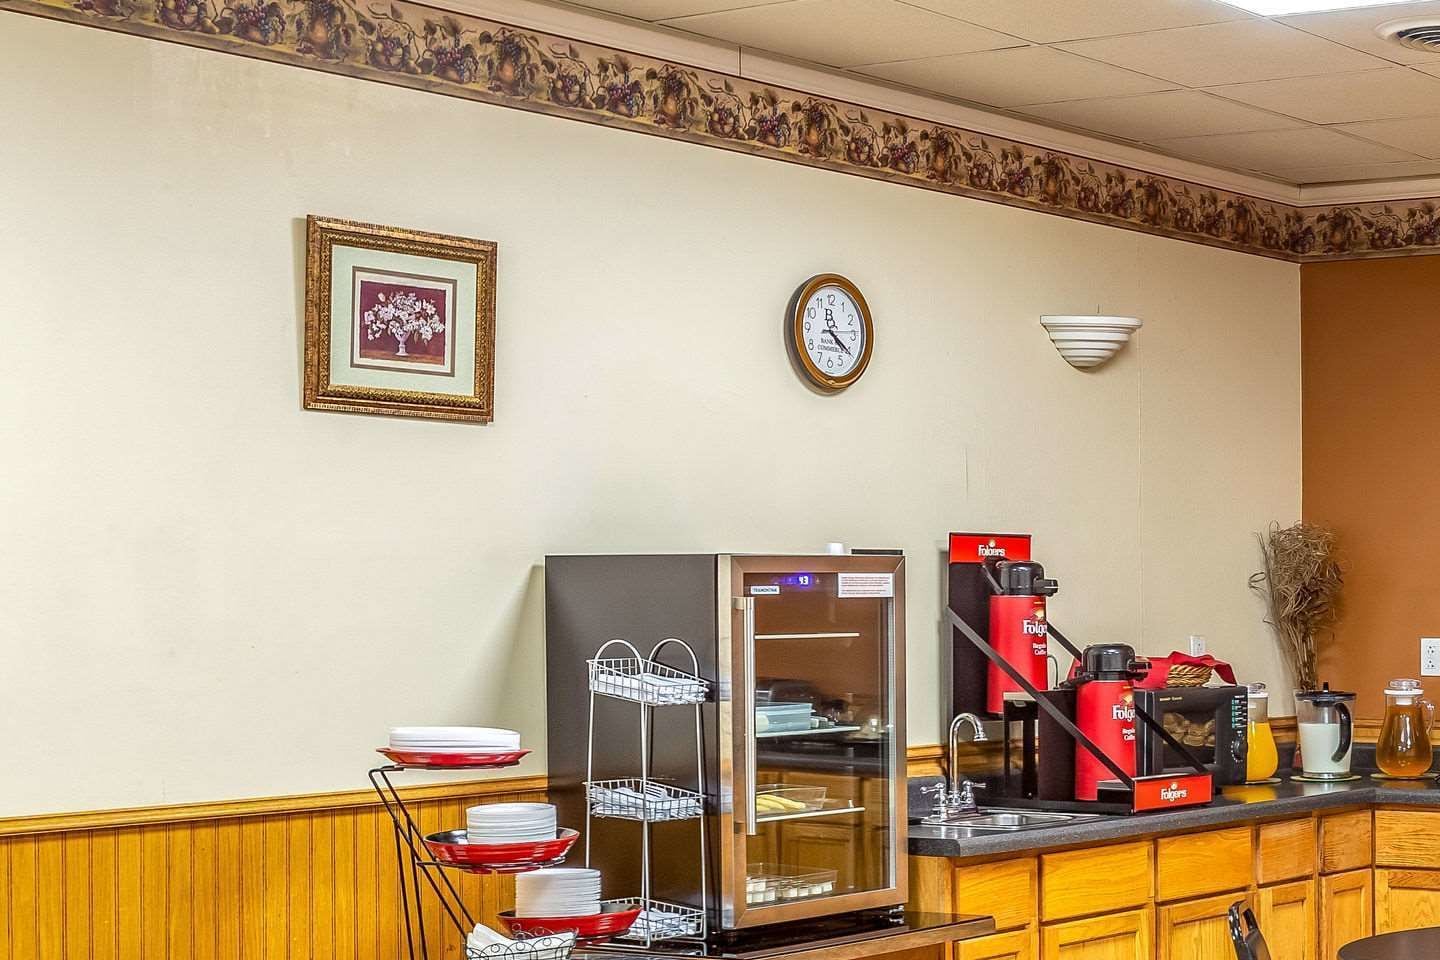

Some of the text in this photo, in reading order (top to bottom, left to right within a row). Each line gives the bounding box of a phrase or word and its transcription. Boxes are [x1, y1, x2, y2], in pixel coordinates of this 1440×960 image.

[816, 297, 823, 309] 11
[827, 294, 836, 306] 12
[807, 307, 816, 319] 10
[848, 314, 853, 326] 2
[805, 322, 811, 333] 9
[850, 329, 857, 342] 3
[808, 339, 814, 350] 8
[817, 352, 823, 363] 7
[827, 357, 833, 368] 6
[837, 355, 843, 367] 5
[1160, 788, 1187, 802] Folgers
